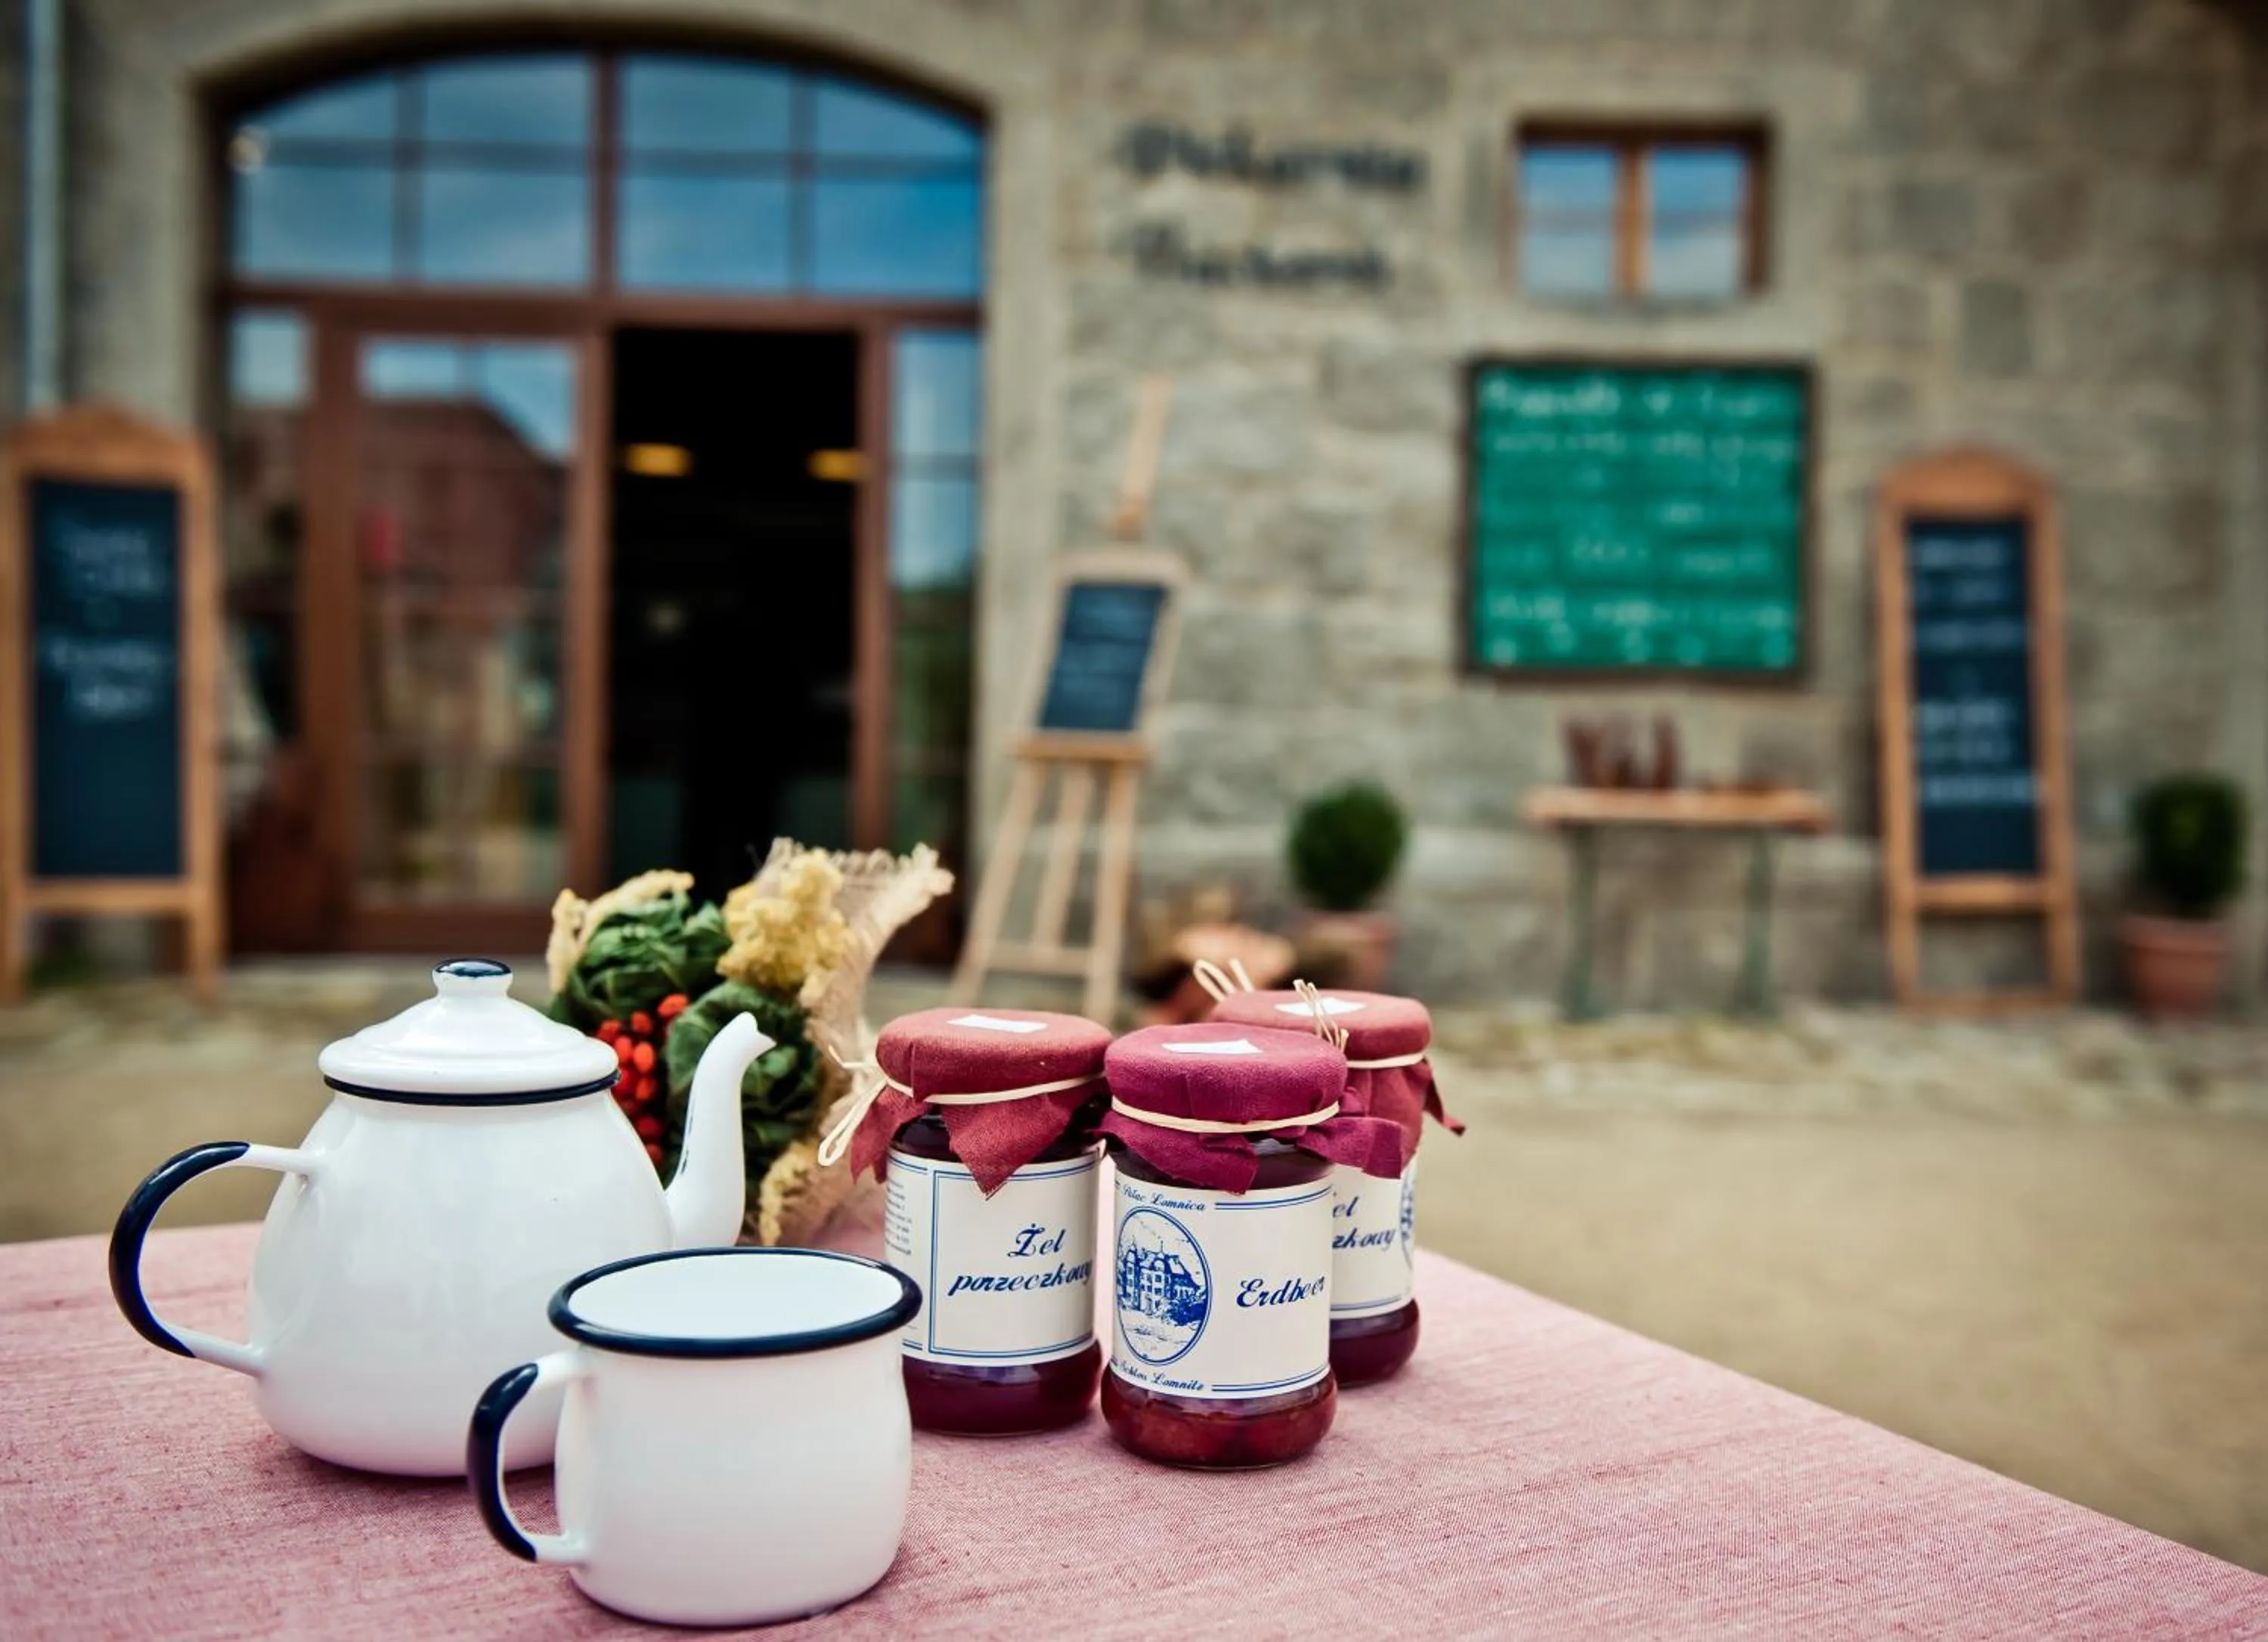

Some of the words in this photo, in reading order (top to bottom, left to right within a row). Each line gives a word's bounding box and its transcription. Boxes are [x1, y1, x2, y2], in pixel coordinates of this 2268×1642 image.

[1332, 1191, 1359, 1218] el
[1007, 1222, 1067, 1257] Żel
[1236, 1275, 1325, 1307] Erdbeer
